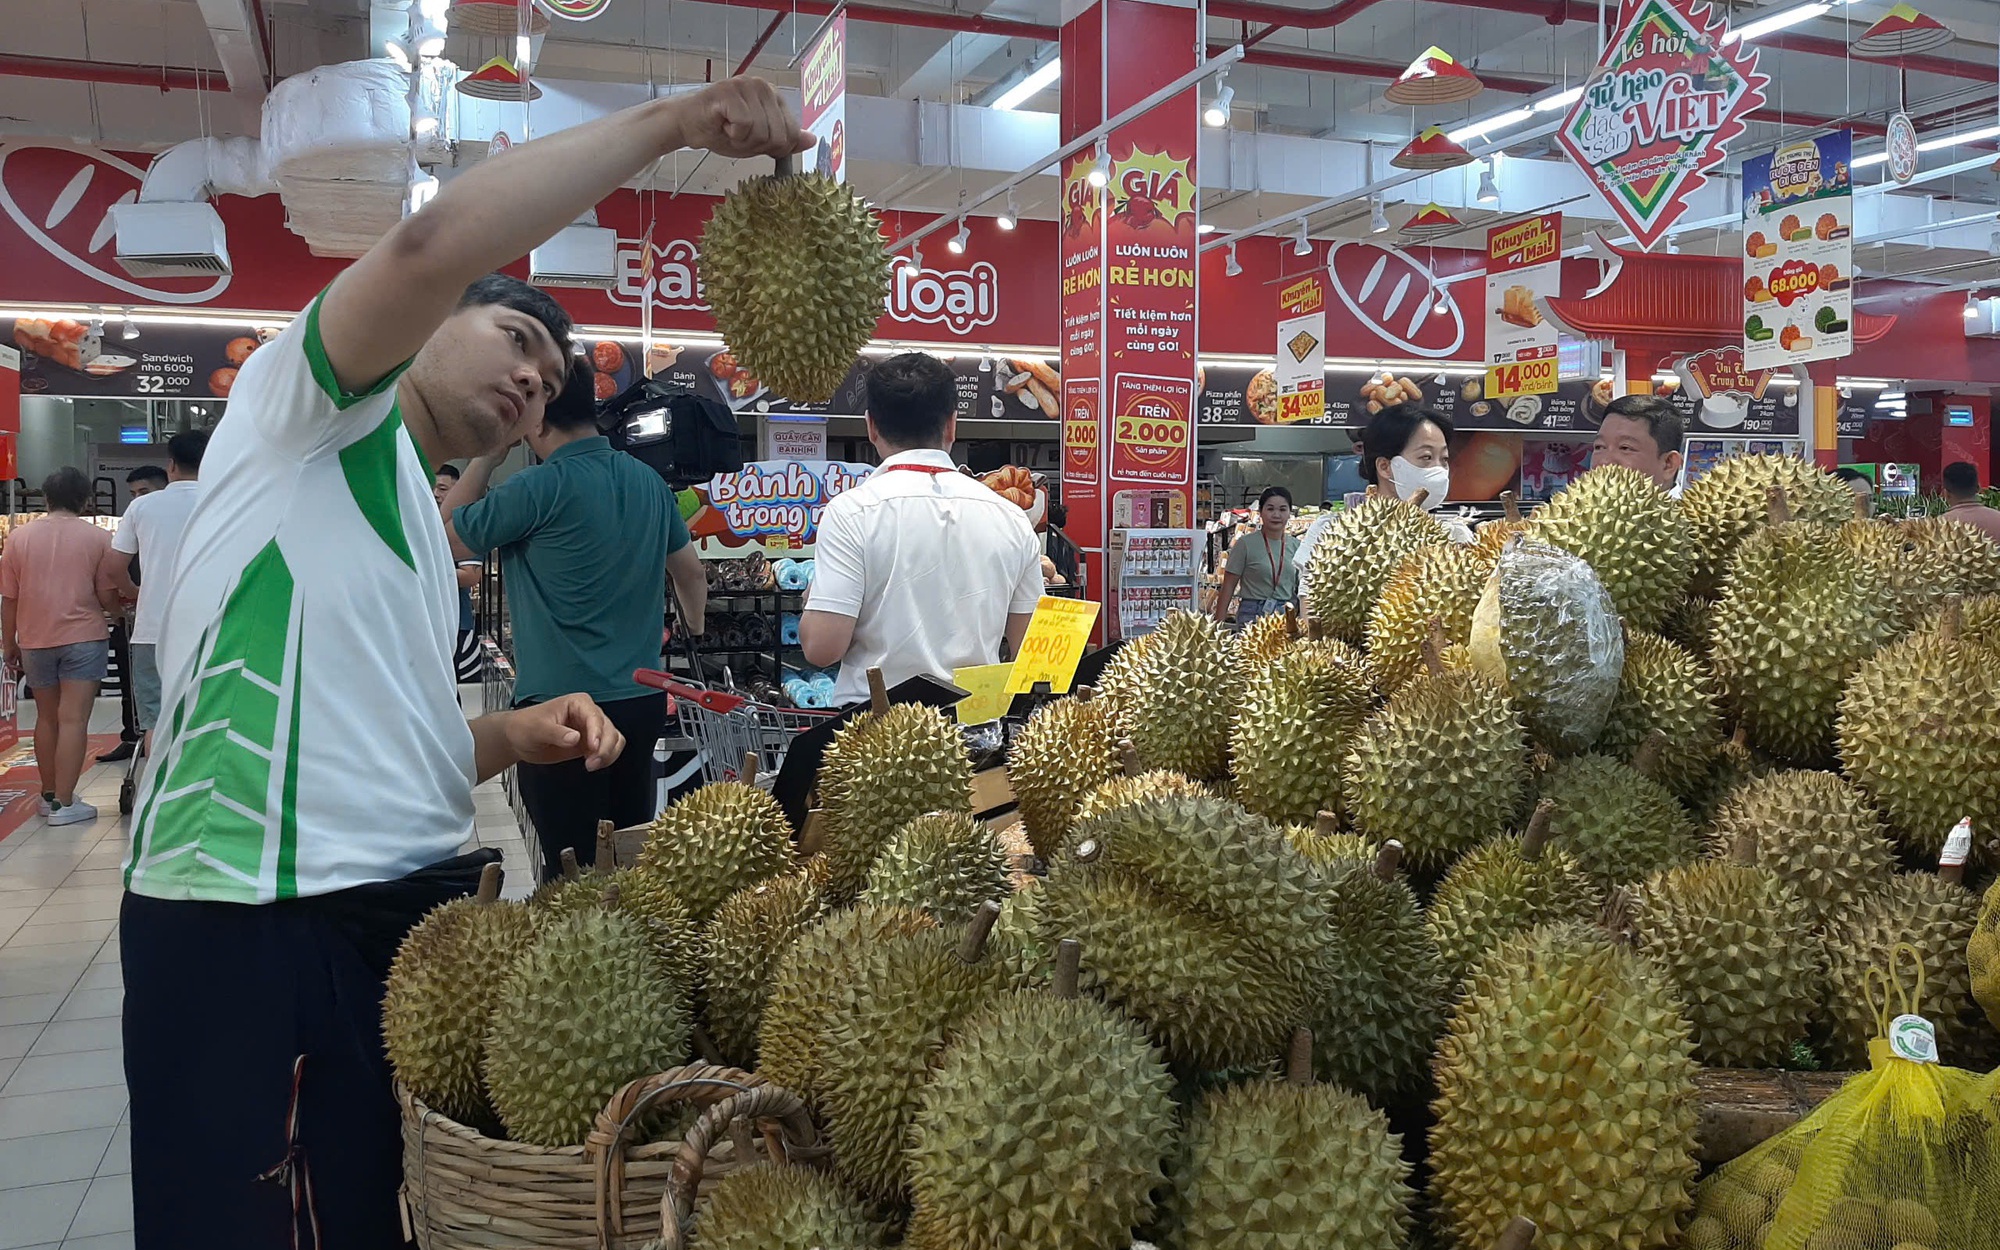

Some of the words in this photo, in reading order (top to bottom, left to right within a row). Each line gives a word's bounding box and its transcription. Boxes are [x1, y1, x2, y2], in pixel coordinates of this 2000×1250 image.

[1621, 35, 1644, 63] Lễ
[1651, 30, 1689, 57] hội
[1613, 72, 1663, 110] hào
[1623, 76, 1727, 139] VIỆT
[1121, 168, 1183, 211] GIÁ
[1493, 223, 1539, 254] Khuyến
[1116, 243, 1150, 257] LUÔN
[1154, 245, 1188, 259] LUÔN
[1063, 269, 1077, 297] RẺ
[1077, 266, 1101, 291] HƠN
[1110, 260, 1140, 285] RẺ
[1144, 267, 1194, 288] HƠN
[1770, 271, 1817, 294] 68.000
[617, 249, 705, 299] Bá
[897, 266, 989, 325] loại
[1282, 281, 1311, 305] Khuyến
[1114, 308, 1137, 320] Tiết
[1140, 309, 1167, 321] kiệm
[1170, 310, 1192, 321] hơn
[1126, 322, 1148, 335] mỗi
[1151, 326, 1179, 338] ngày
[1126, 341, 1155, 352] cùng
[1158, 341, 1179, 351] GO!
[141, 363, 161, 372] nho
[164, 363, 194, 374] 600g
[142, 354, 193, 363] Sandwich
[136, 375, 190, 393] 32.000
[673, 371, 696, 380] Bánh
[1143, 382, 1162, 392] THÊM
[1494, 362, 1551, 394] 14.000
[1205, 390, 1223, 398] Pizza
[1281, 392, 1320, 418] 34.000
[1137, 404, 1170, 418] TRÊN
[1201, 407, 1239, 423] 38.000
[1066, 425, 1096, 444] 2.000
[1118, 421, 1186, 444] 2.000
[1135, 445, 1148, 454] Sản
[711, 464, 813, 500] Bánh
[728, 503, 803, 532] trong
